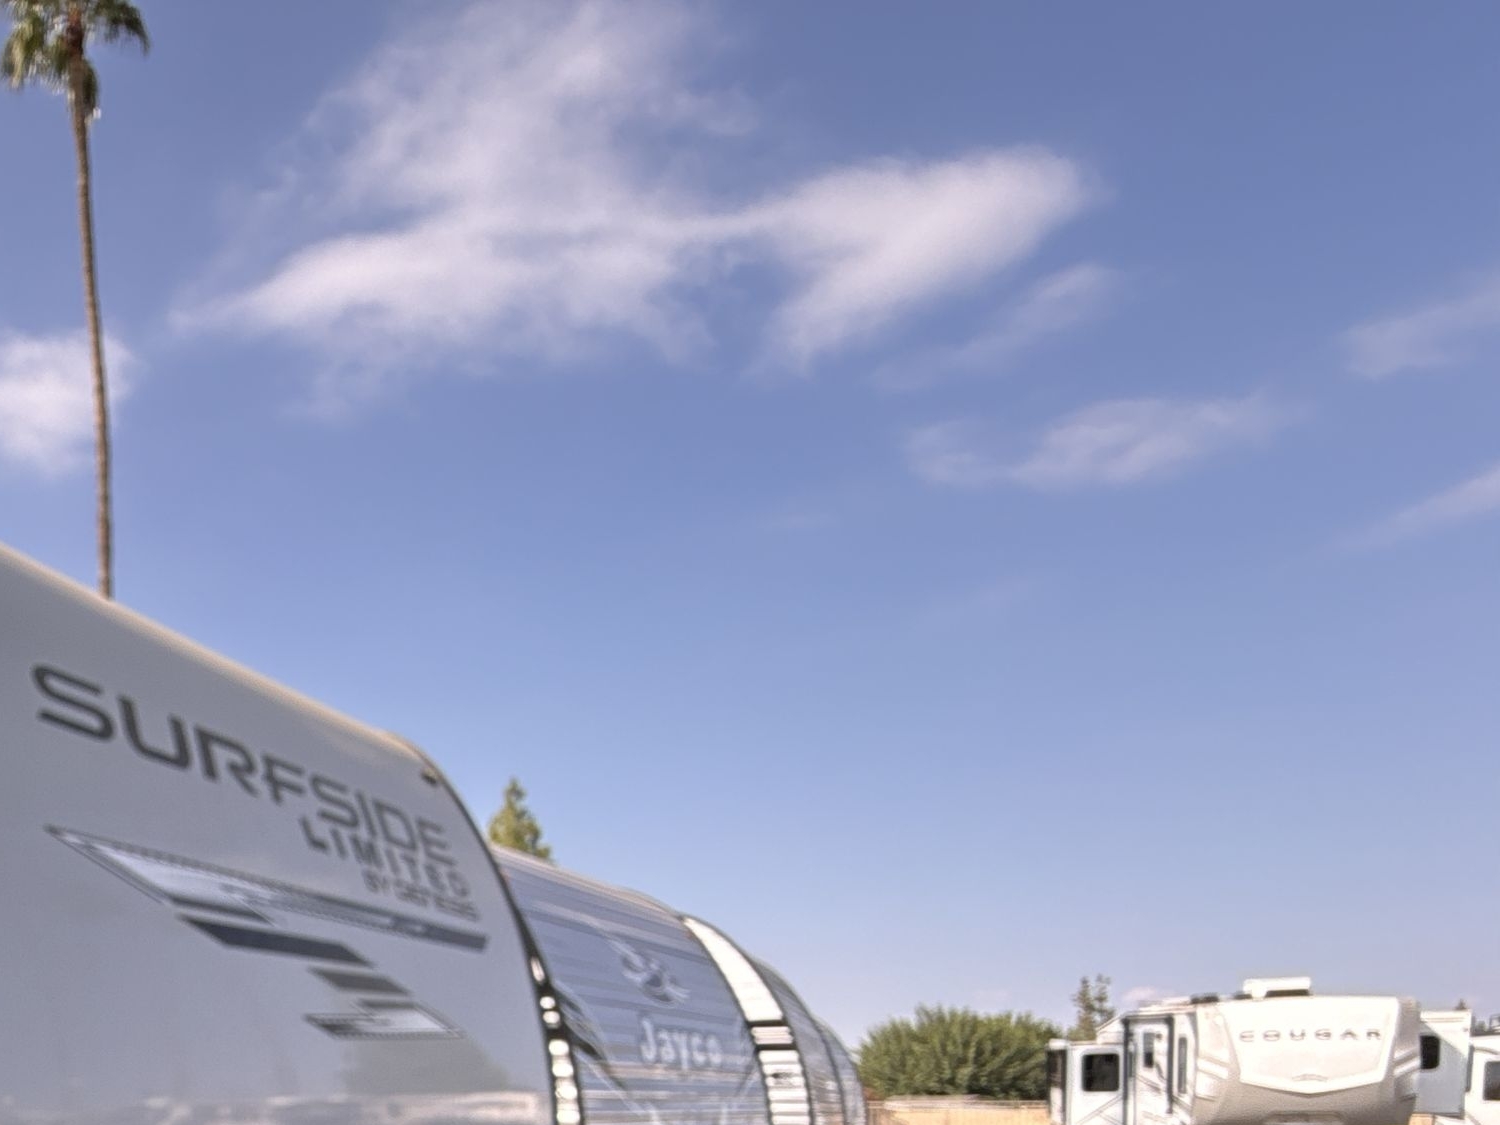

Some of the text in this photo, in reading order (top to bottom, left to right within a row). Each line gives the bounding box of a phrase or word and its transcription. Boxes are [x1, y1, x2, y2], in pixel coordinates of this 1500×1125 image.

[31, 663, 457, 867] SURFSIDE
[300, 816, 470, 898] LIMITED
[640, 1018, 722, 1071] Jayco
[1238, 1028, 1381, 1043] COUGAR
